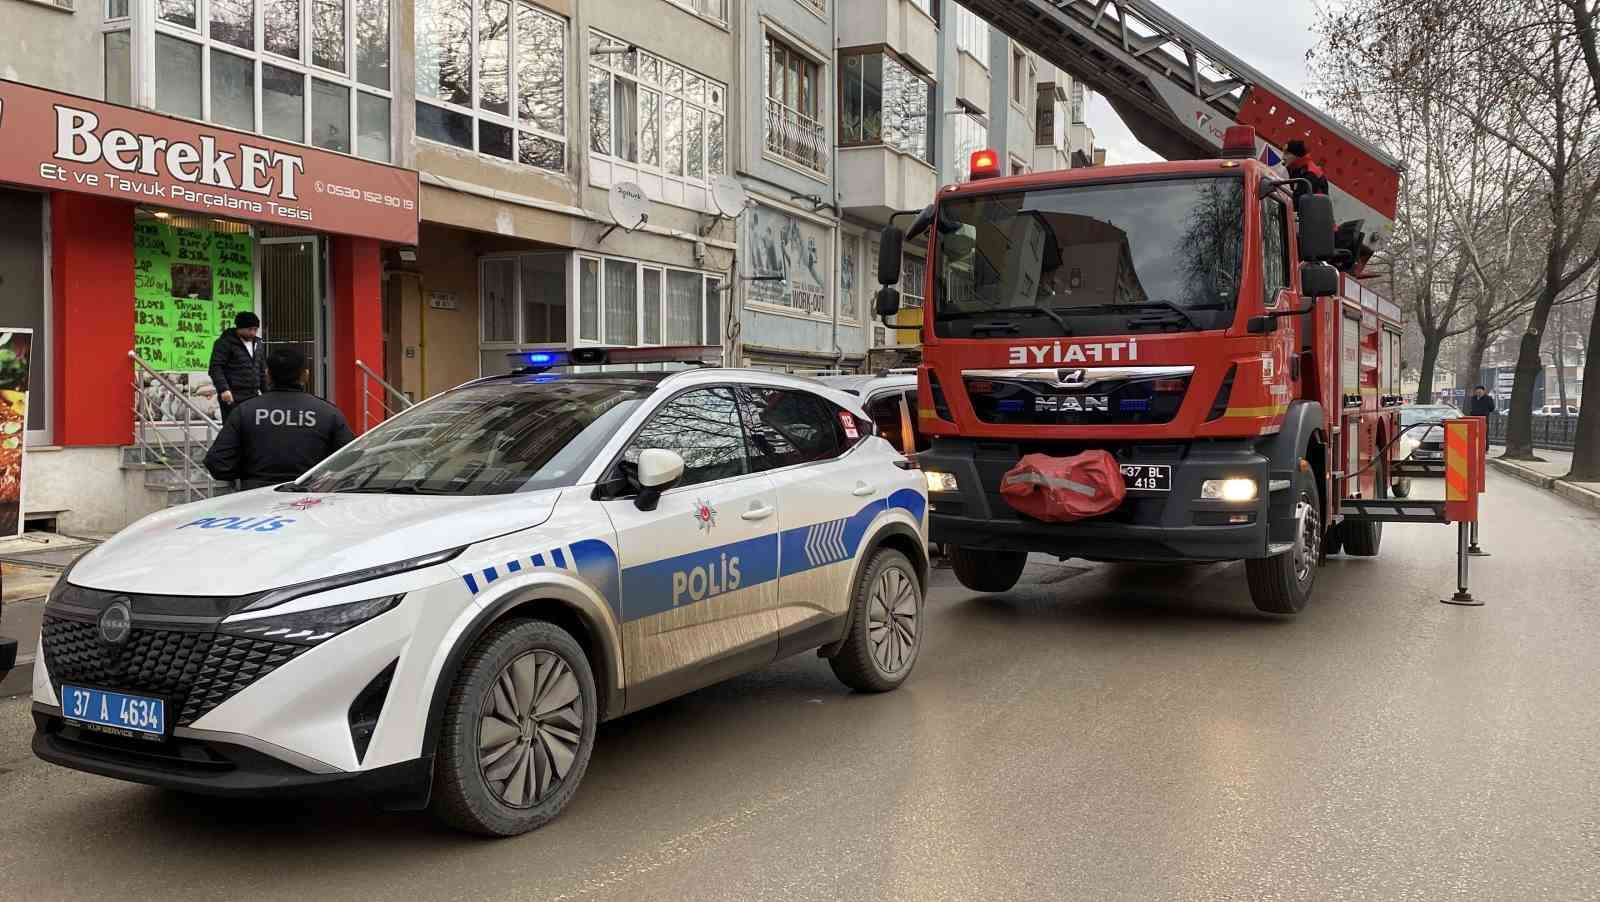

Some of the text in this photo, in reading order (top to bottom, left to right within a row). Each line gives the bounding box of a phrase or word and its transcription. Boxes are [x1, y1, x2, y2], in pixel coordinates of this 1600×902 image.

[53, 104, 304, 200] BerekET
[40, 163, 313, 221] Et ve Tavuk Parçalama Tesisi
[326, 183, 414, 210] 0530 152 90 19
[1035, 396, 1109, 412] MAN
[1127, 467, 1164, 478] 37 BL
[1134, 478, 1156, 489] 419
[73, 690, 158, 729] 37 A 4634
